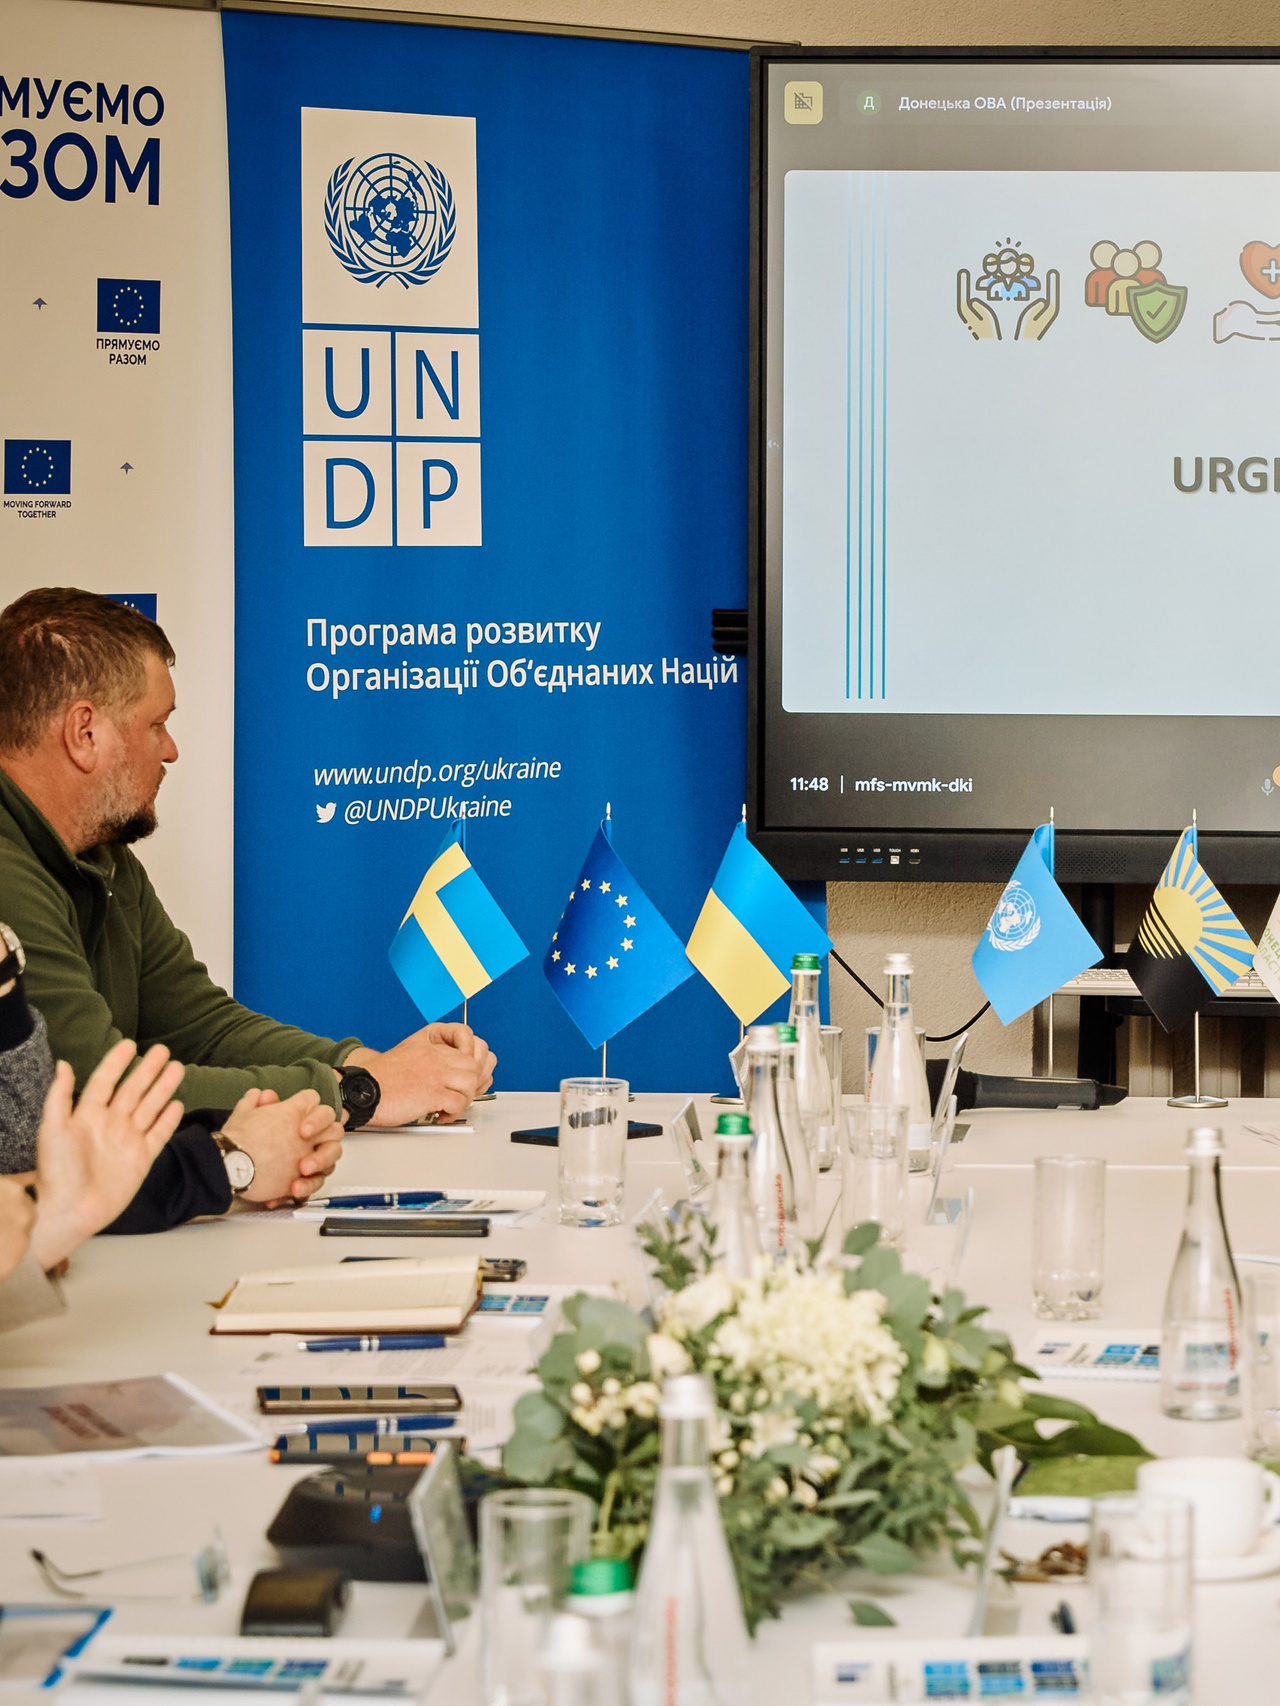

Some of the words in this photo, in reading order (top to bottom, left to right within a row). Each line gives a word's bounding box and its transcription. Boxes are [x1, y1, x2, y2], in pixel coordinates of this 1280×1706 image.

[899, 96, 970, 111] Донецька
[974, 97, 1007, 109] ОВА
[1011, 96, 1112, 111] (Презентація)
[0, 128, 160, 206] ЗОМ
[96, 338, 160, 351] ПРЯМУЄМО
[109, 353, 147, 365] РАЗОМ
[3, 501, 34, 509] MOVING
[34, 501, 72, 509] FORWARD
[18, 510, 57, 518] TOGETHER
[306, 617, 457, 655] Програма
[466, 621, 602, 653] розвитку
[306, 658, 479, 700] Організації
[661, 655, 738, 690] Націй
[313, 757, 562, 789] www.undp.org/ukraine
[790, 777, 829, 791] 11:48
[854, 777, 973, 793] mfs-mvmk-dki
[344, 795, 512, 825] @UNDPUkraine
